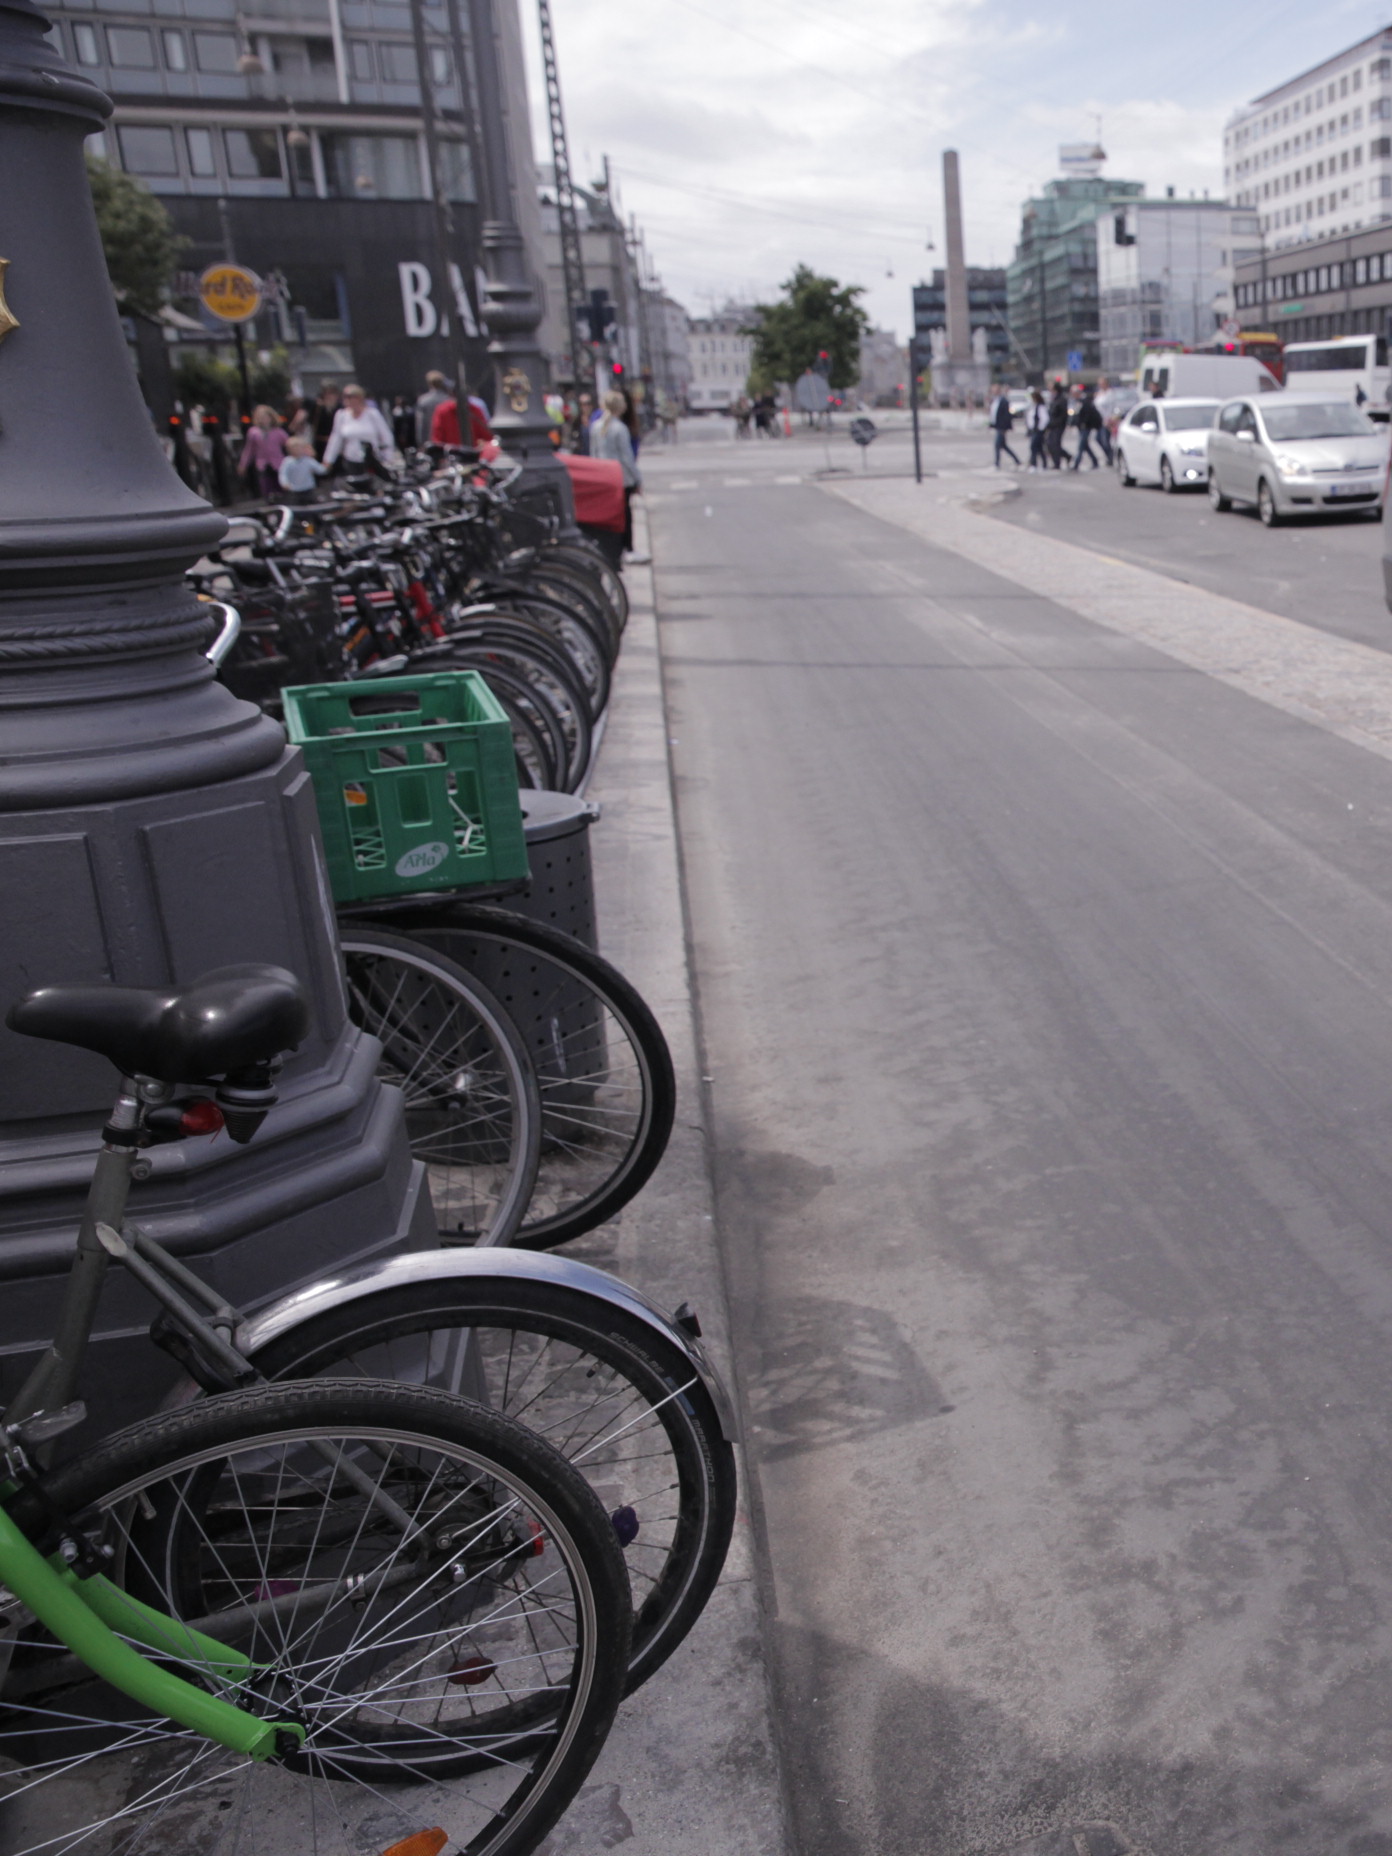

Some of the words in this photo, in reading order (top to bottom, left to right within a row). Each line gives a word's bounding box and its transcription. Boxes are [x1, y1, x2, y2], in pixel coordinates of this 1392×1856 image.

[403, 852, 436, 869] Arla
[609, 1331, 665, 1373] SCHWALBE
[691, 1418, 716, 1483] MARATHON
